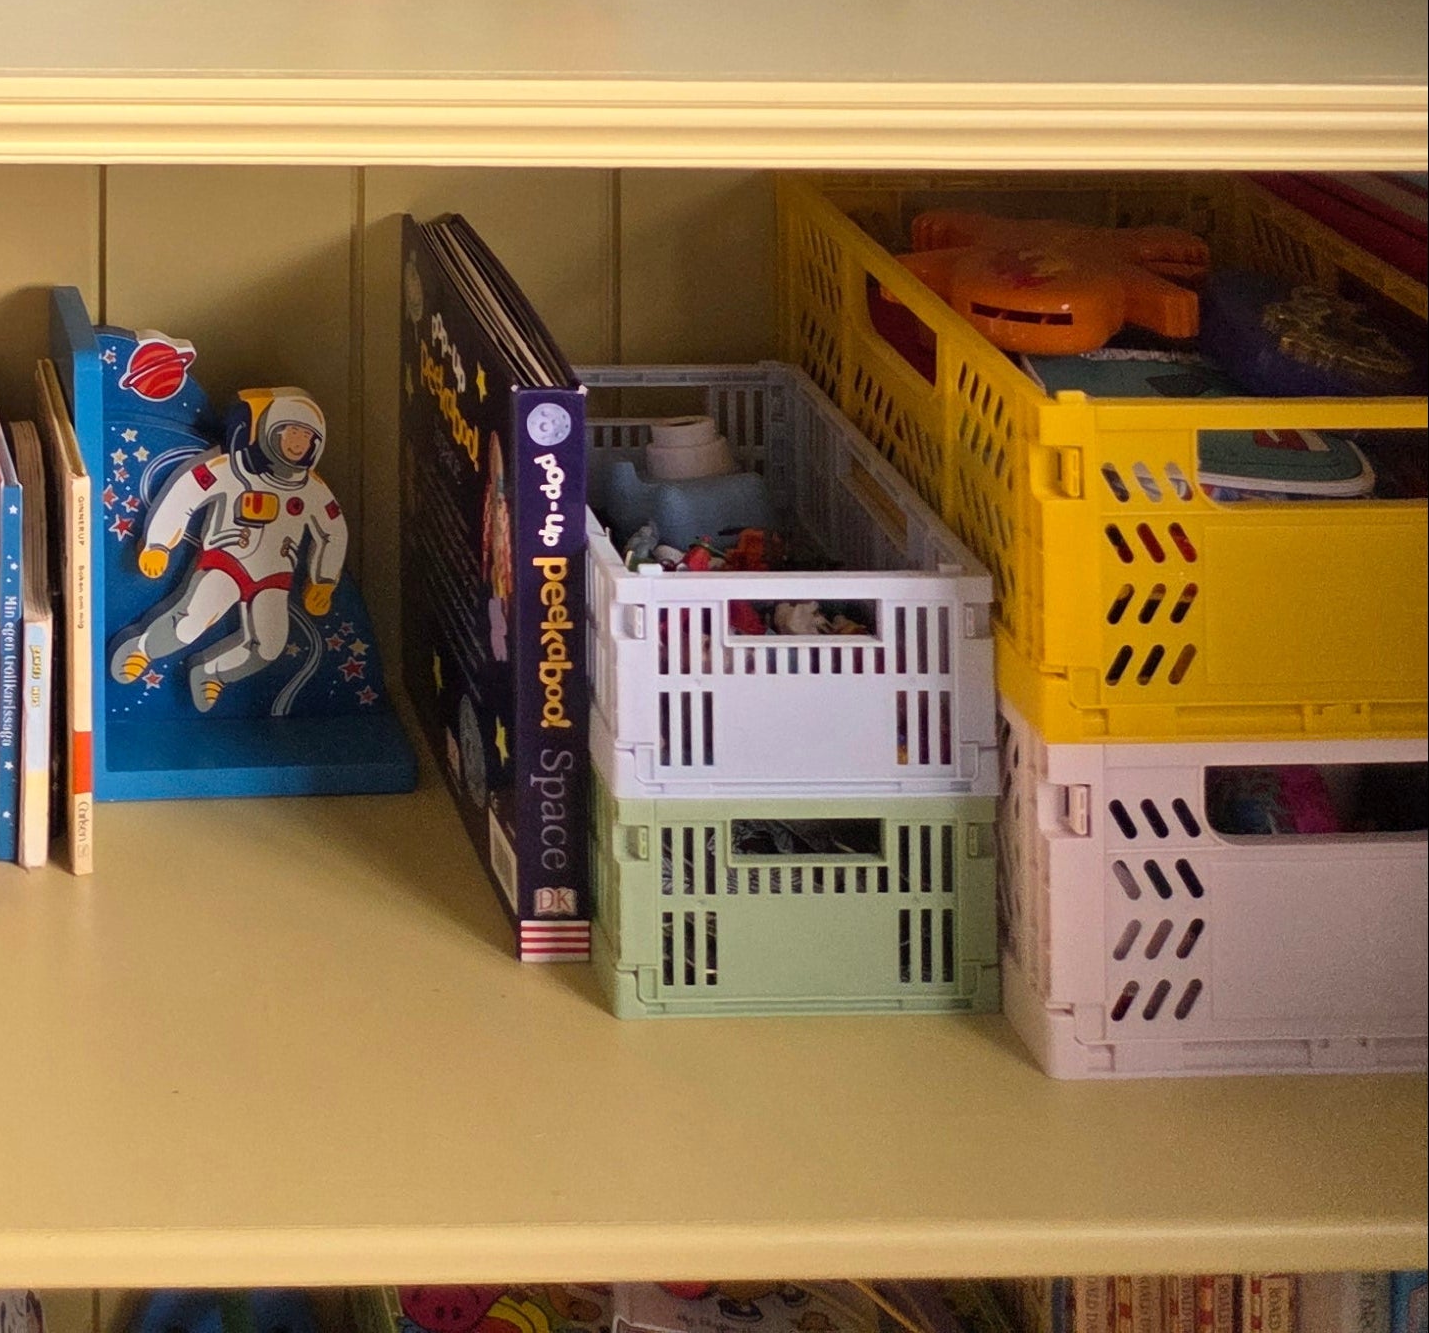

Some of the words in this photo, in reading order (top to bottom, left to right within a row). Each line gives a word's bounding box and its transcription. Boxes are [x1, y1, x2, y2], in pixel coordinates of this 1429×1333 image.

[534, 454, 567, 546] pop-up
[3, 622, 16, 652] egen
[5, 596, 18, 618] Min
[533, 557, 574, 728] peekaboo!
[1, 656, 18, 747] trollkarlssaga
[530, 749, 574, 870] Space
[538, 890, 575, 914] DK
